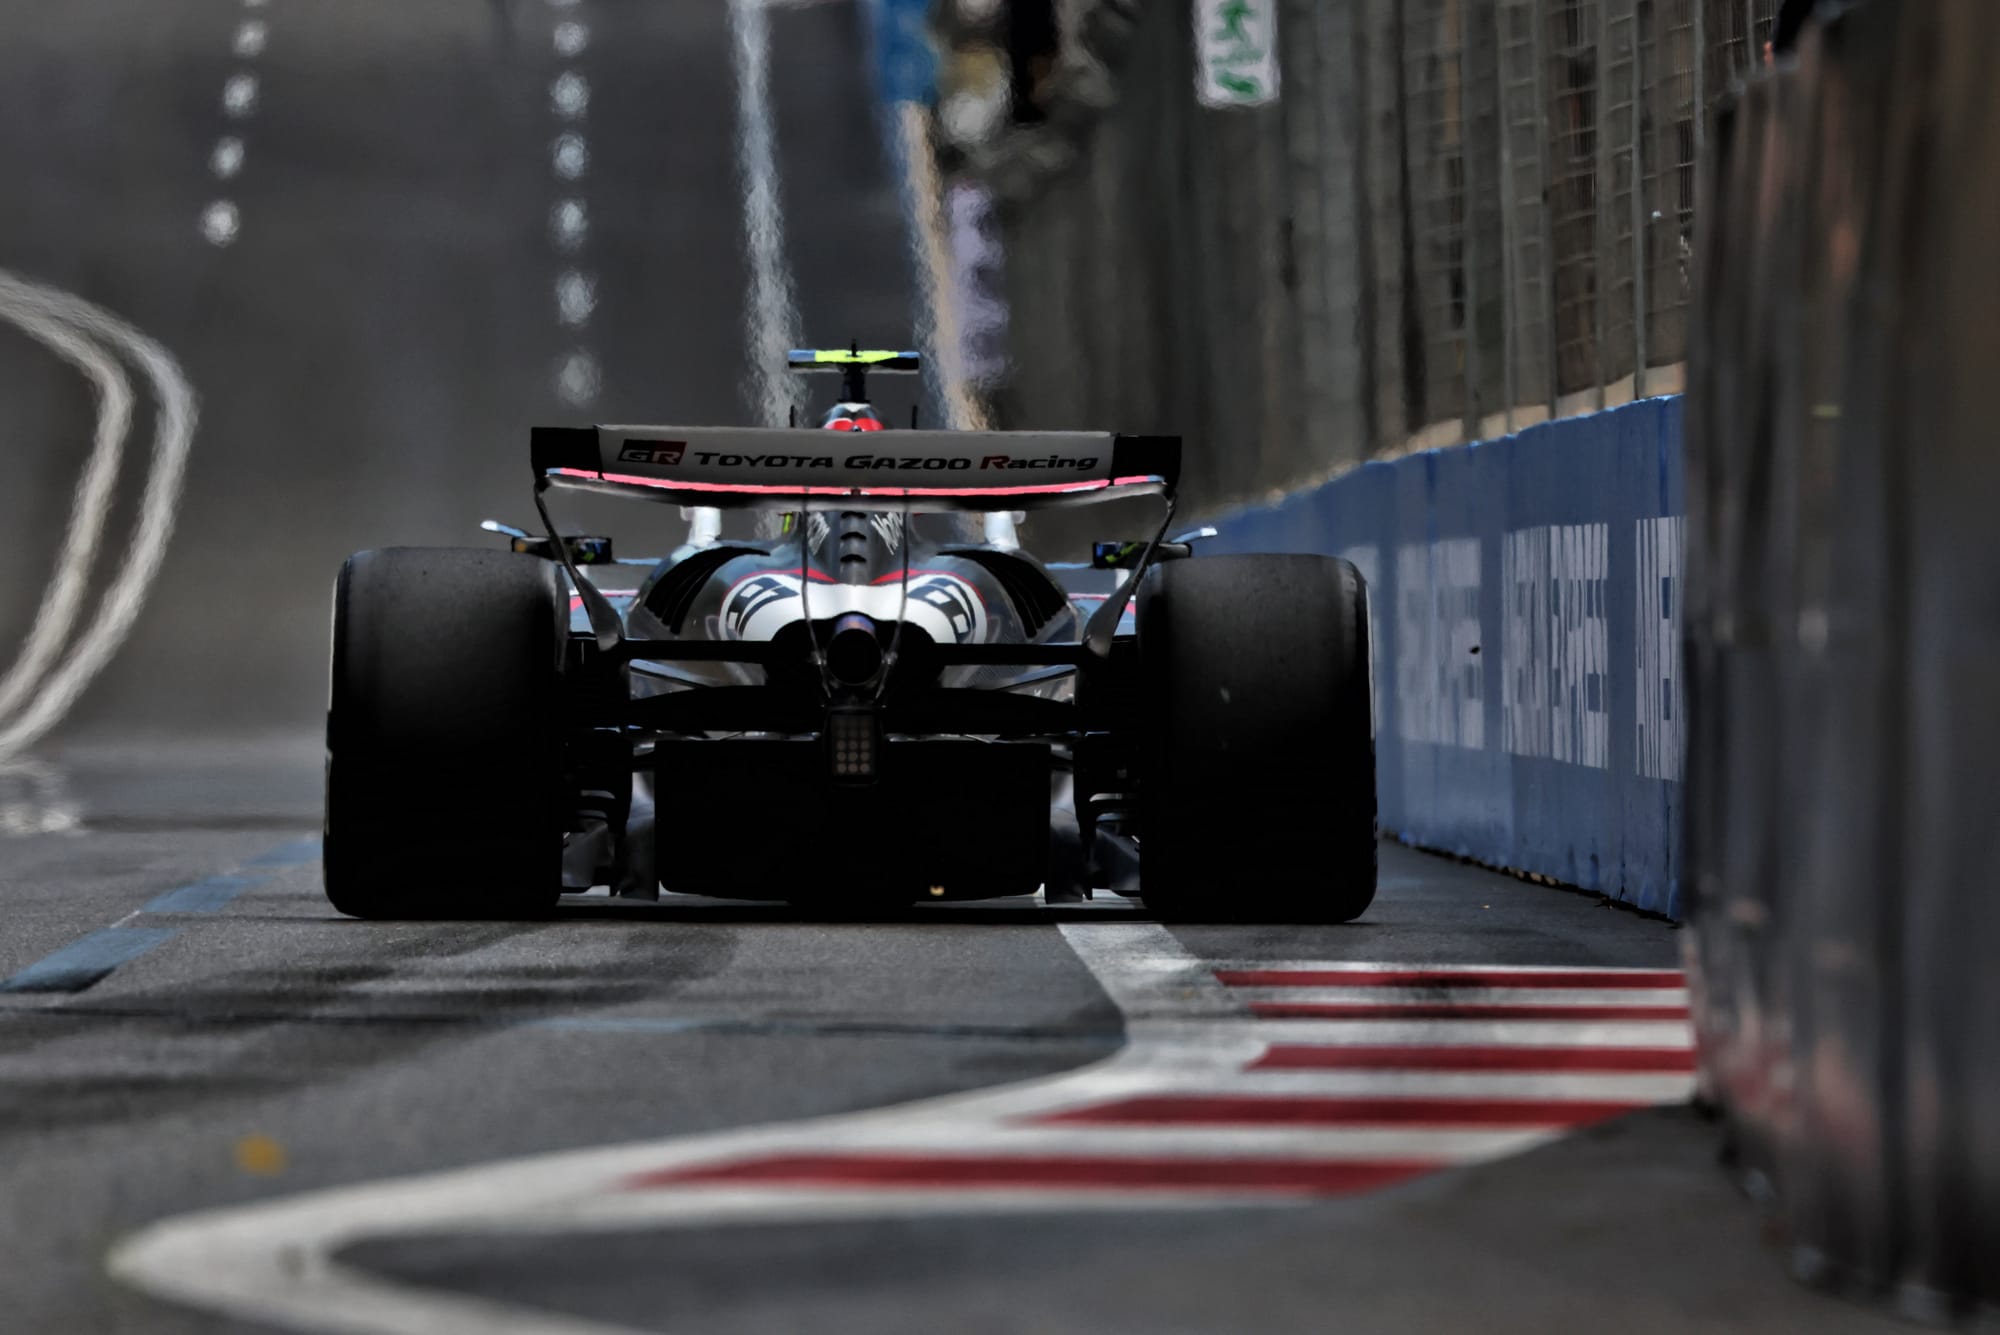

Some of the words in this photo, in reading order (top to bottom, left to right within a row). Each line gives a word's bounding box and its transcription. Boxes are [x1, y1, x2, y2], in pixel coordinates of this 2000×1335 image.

[620, 447, 684, 465] GR
[694, 452, 833, 467] TOYOTA
[844, 455, 971, 470] GAZOO
[979, 454, 1099, 471] Racing
